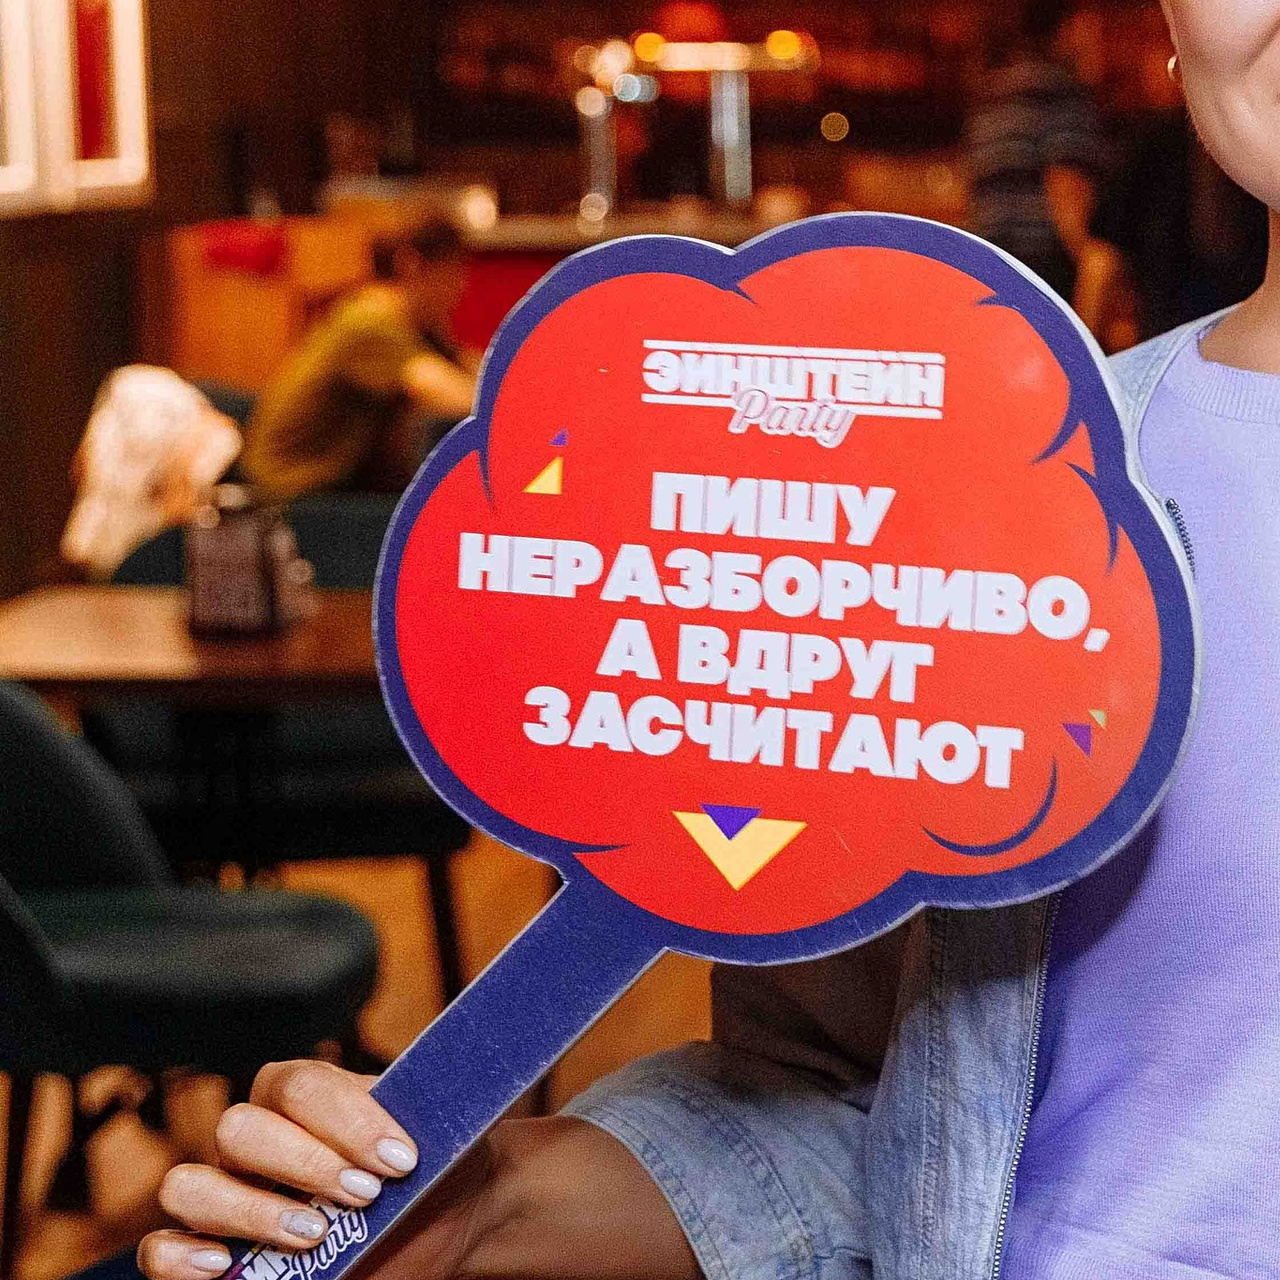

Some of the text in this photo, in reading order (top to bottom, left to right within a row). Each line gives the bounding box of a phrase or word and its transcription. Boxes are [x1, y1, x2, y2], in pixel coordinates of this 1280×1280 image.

[728, 388, 858, 448] Party
[650, 471, 896, 547] ПИШУ
[457, 532, 1111, 653] НЕРАЗБОРЧИВО,
[595, 618, 934, 704] А ВДРУГ
[522, 686, 1024, 790] ЗАСЧИТАЮТ
